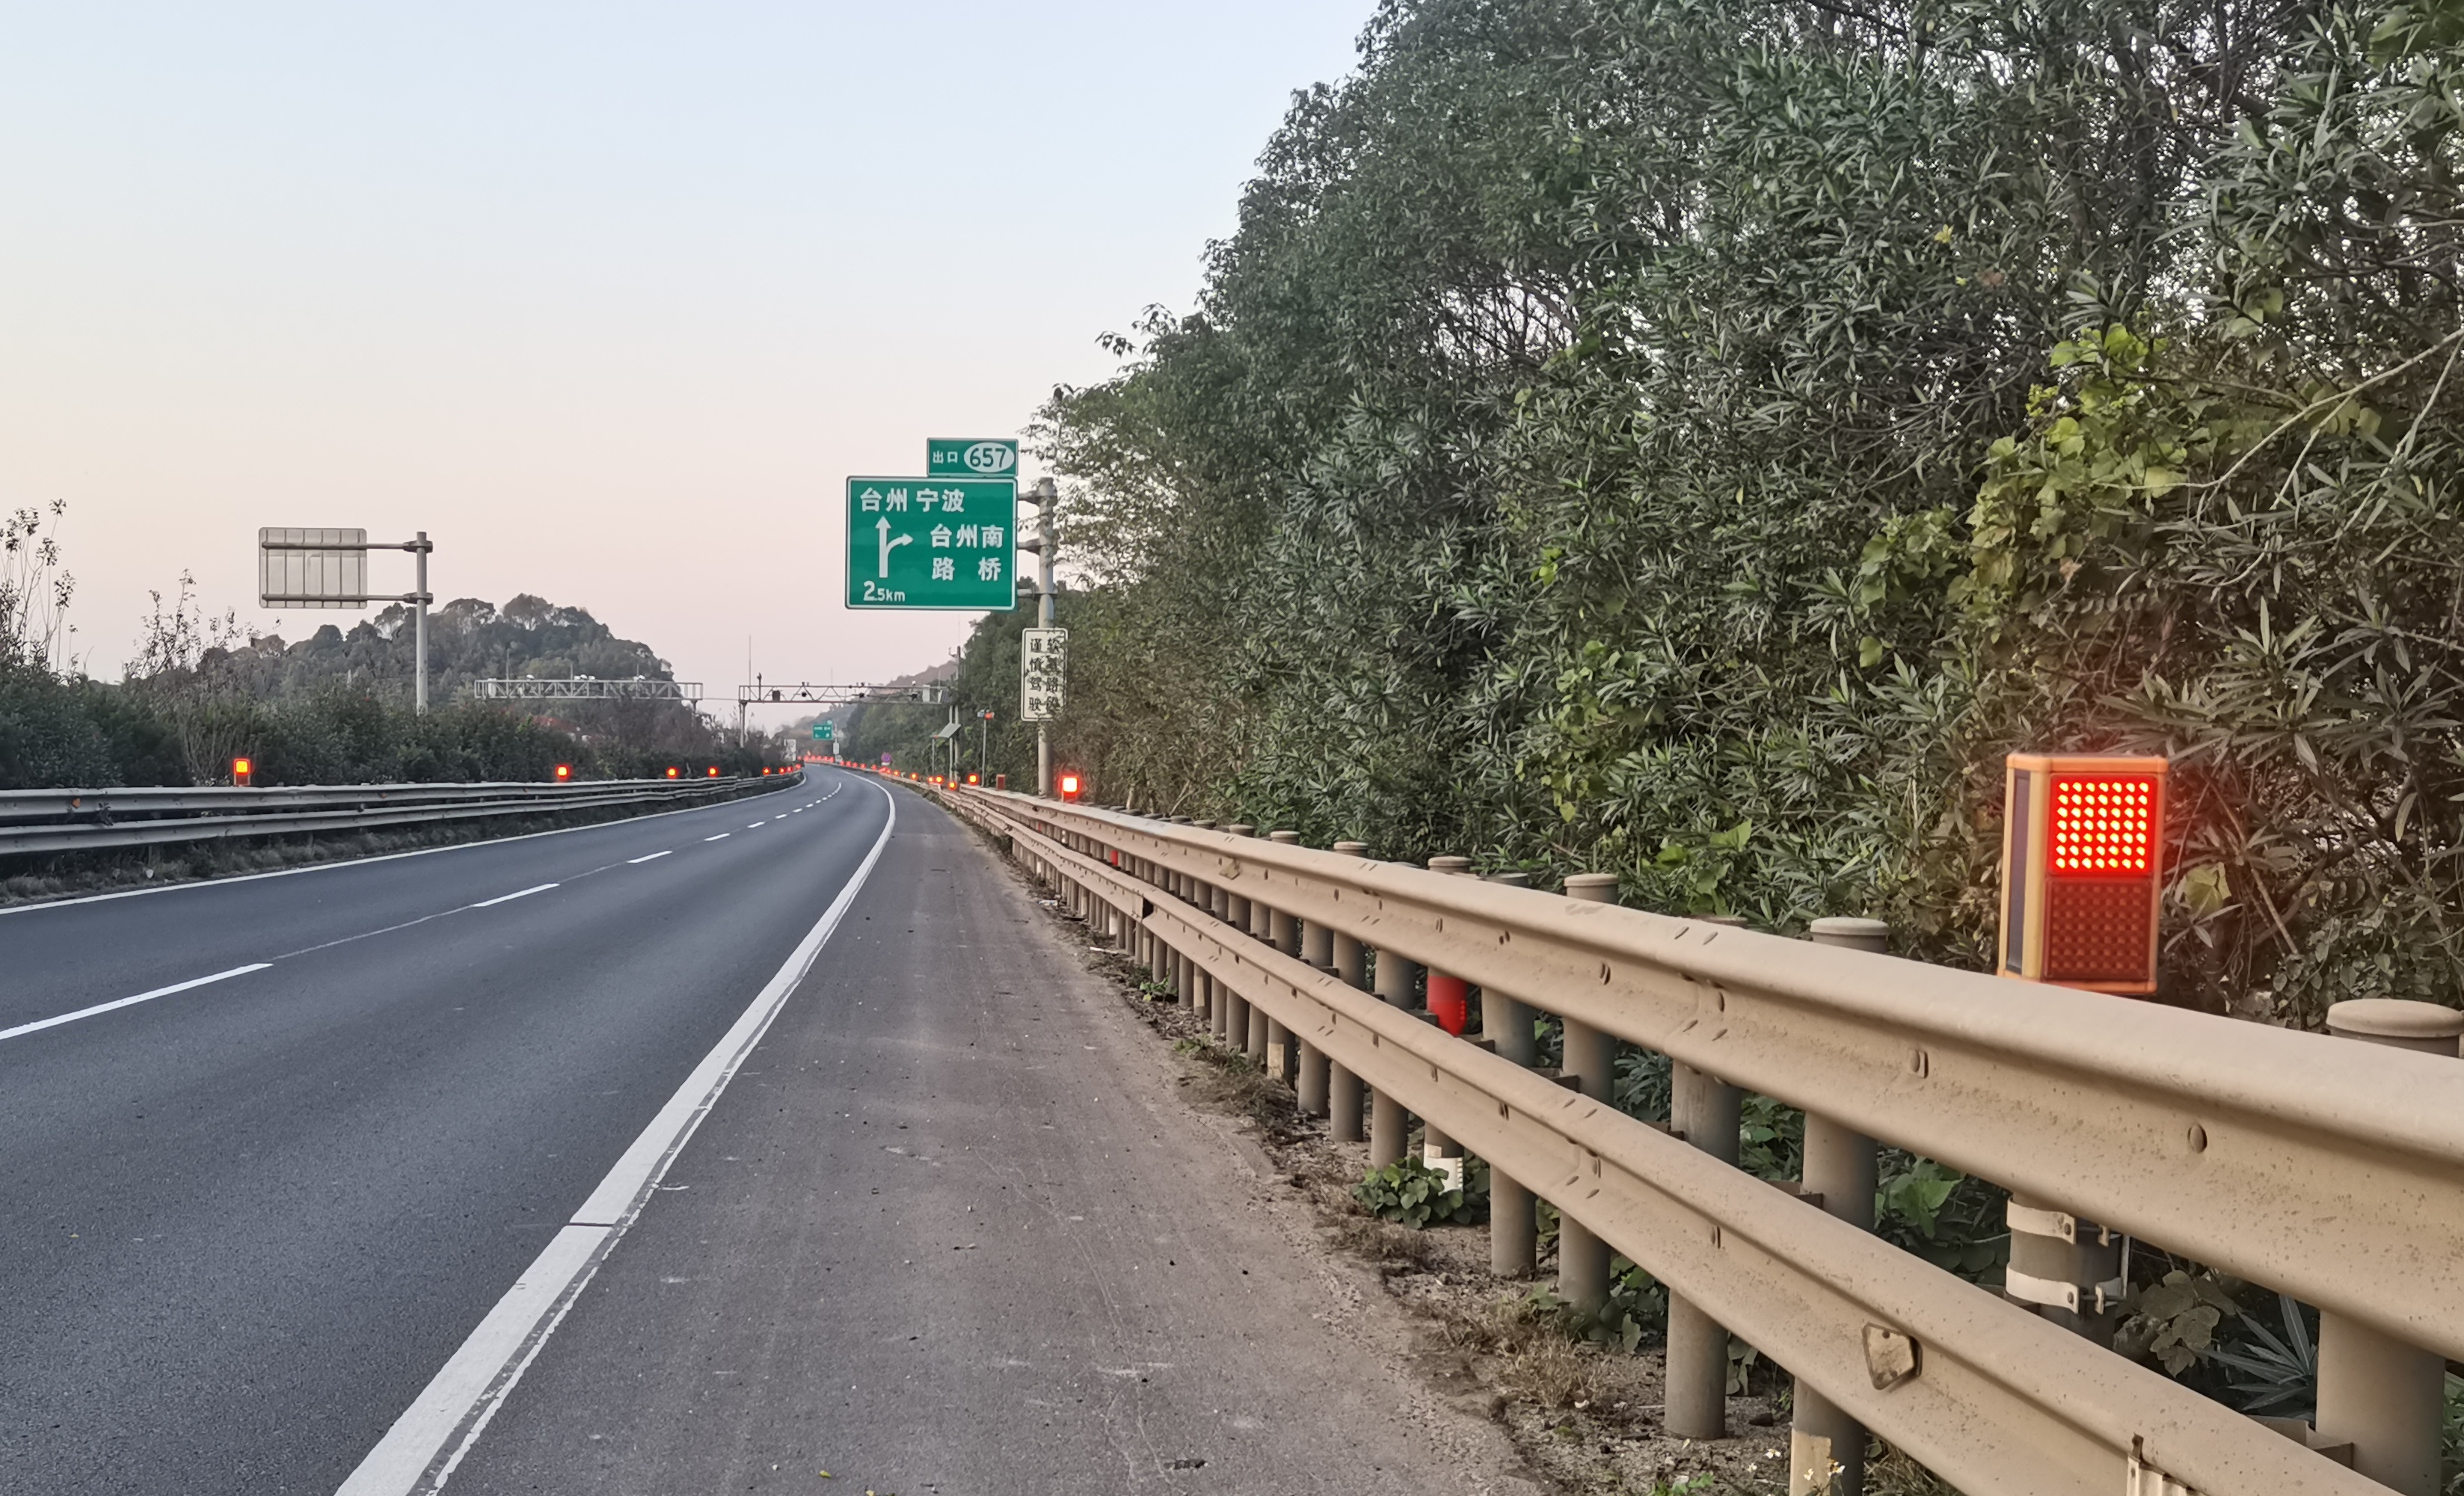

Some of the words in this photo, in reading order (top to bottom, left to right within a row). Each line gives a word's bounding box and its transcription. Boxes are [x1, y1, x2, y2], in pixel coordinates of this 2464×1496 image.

[933, 450, 958, 464] 出口
[969, 448, 1007, 468] 657
[860, 487, 908, 512] 台州
[916, 487, 965, 513] 宁波
[930, 523, 1004, 549] 台州南
